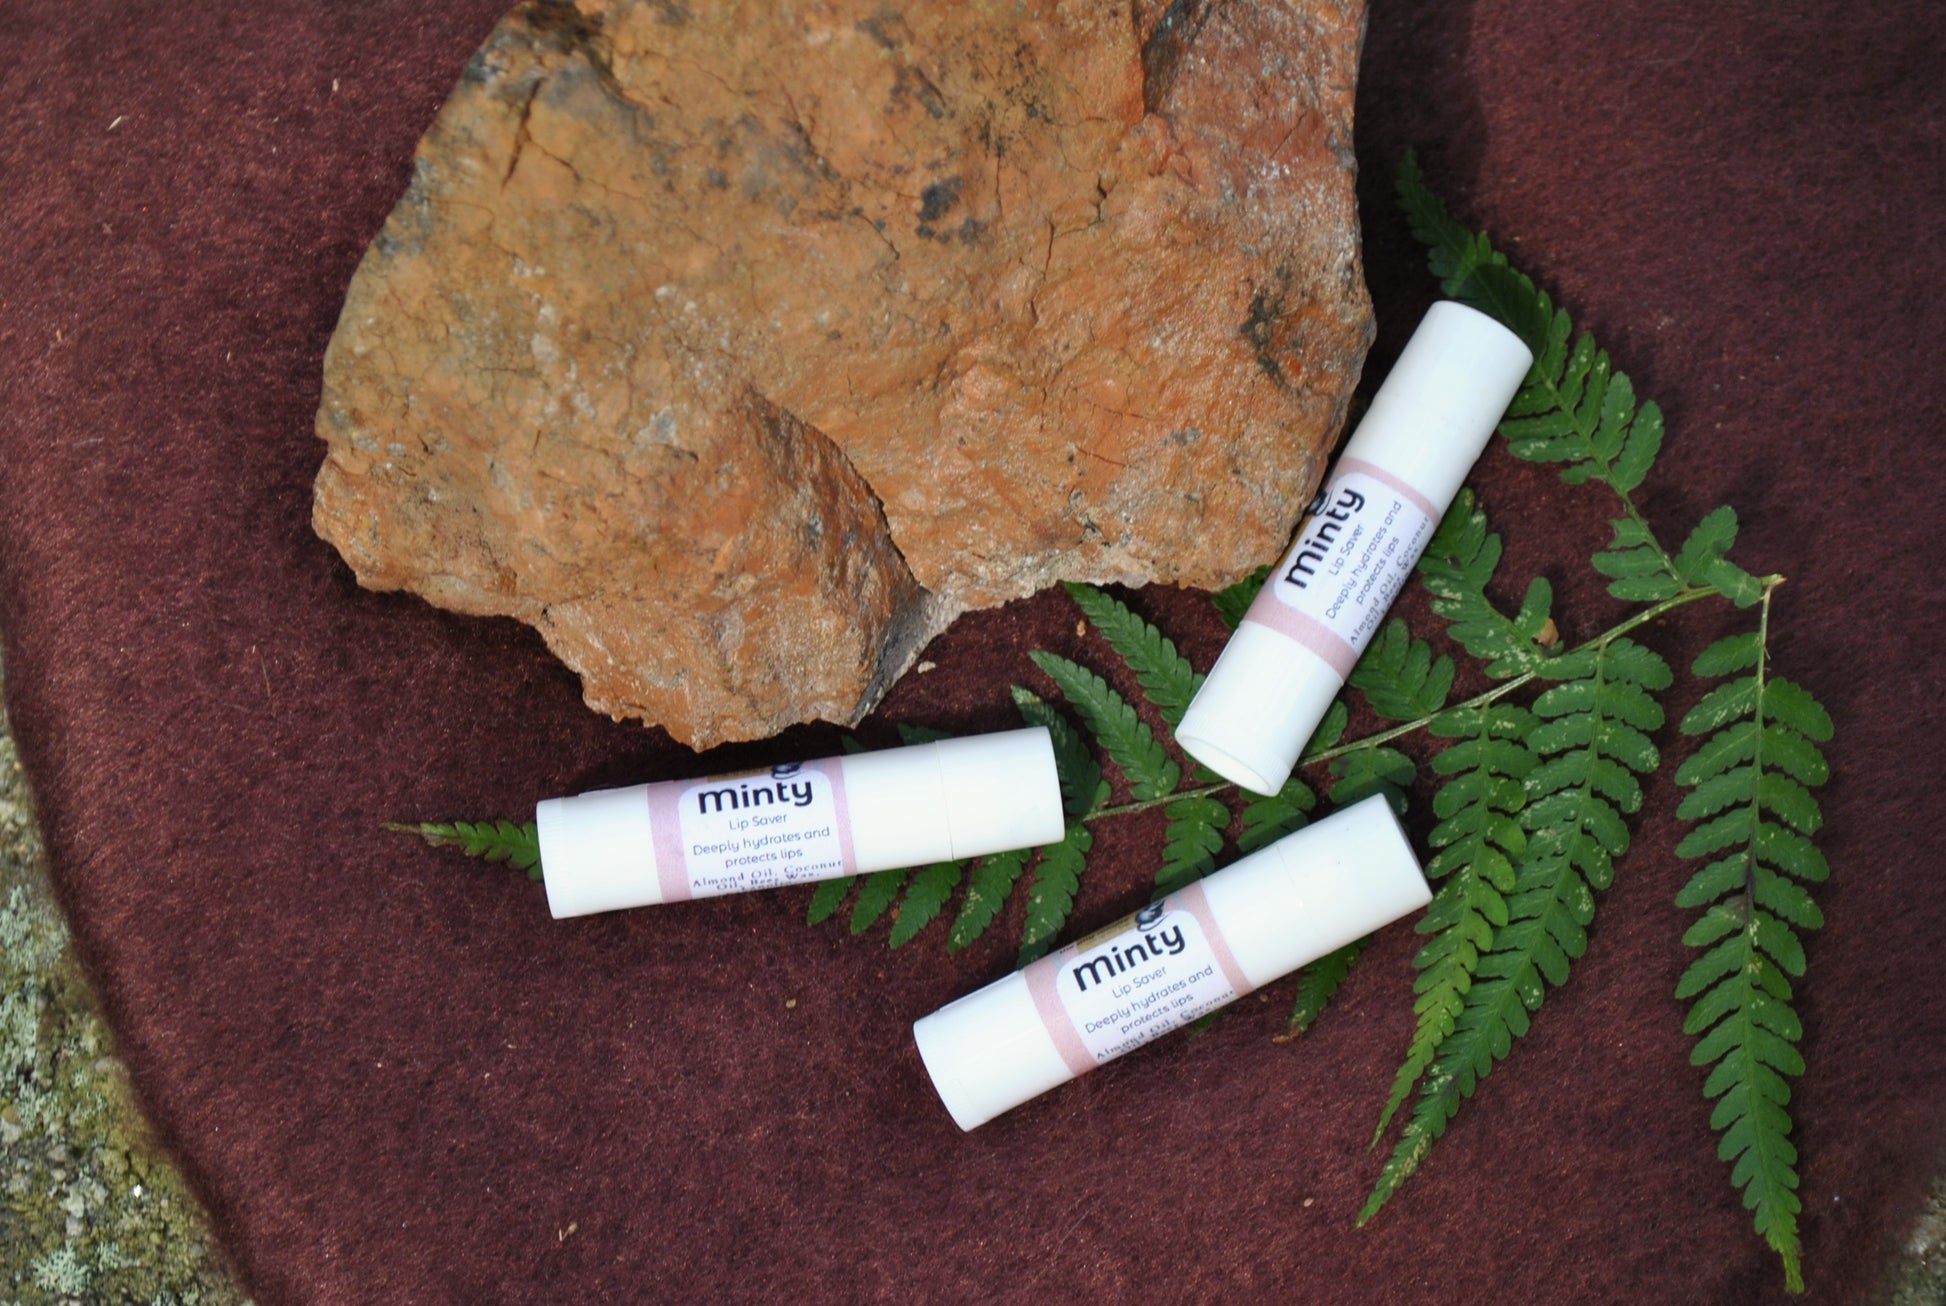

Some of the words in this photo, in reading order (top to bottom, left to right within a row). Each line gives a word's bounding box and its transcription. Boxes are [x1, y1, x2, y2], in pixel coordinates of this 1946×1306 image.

[1285, 488, 1365, 589] minty
[1325, 580, 1356, 620] Deeply
[1352, 527, 1387, 578] hydrates
[1385, 500, 1402, 526] and
[1328, 559, 1344, 576] Lip
[1341, 524, 1364, 556] Saver
[1356, 559, 1386, 605] protects
[1383, 536, 1399, 557] lips
[698, 780, 813, 814] minty
[693, 840, 740, 856] Deeply
[743, 832, 801, 850] hydrates
[804, 826, 830, 840] and
[729, 818, 749, 831] Lip
[752, 814, 787, 827] Saver
[725, 851, 777, 868] protects
[780, 848, 803, 860] lips
[1073, 925, 1185, 992] minty
[1085, 1008, 1131, 1034] Deeply
[1131, 979, 1187, 1011] hydrates
[1188, 964, 1214, 984] and
[1112, 982, 1132, 998] Lip
[1132, 966, 1167, 988] Saver
[1121, 1006, 1170, 1034] protects
[1171, 994, 1194, 1008] lips
